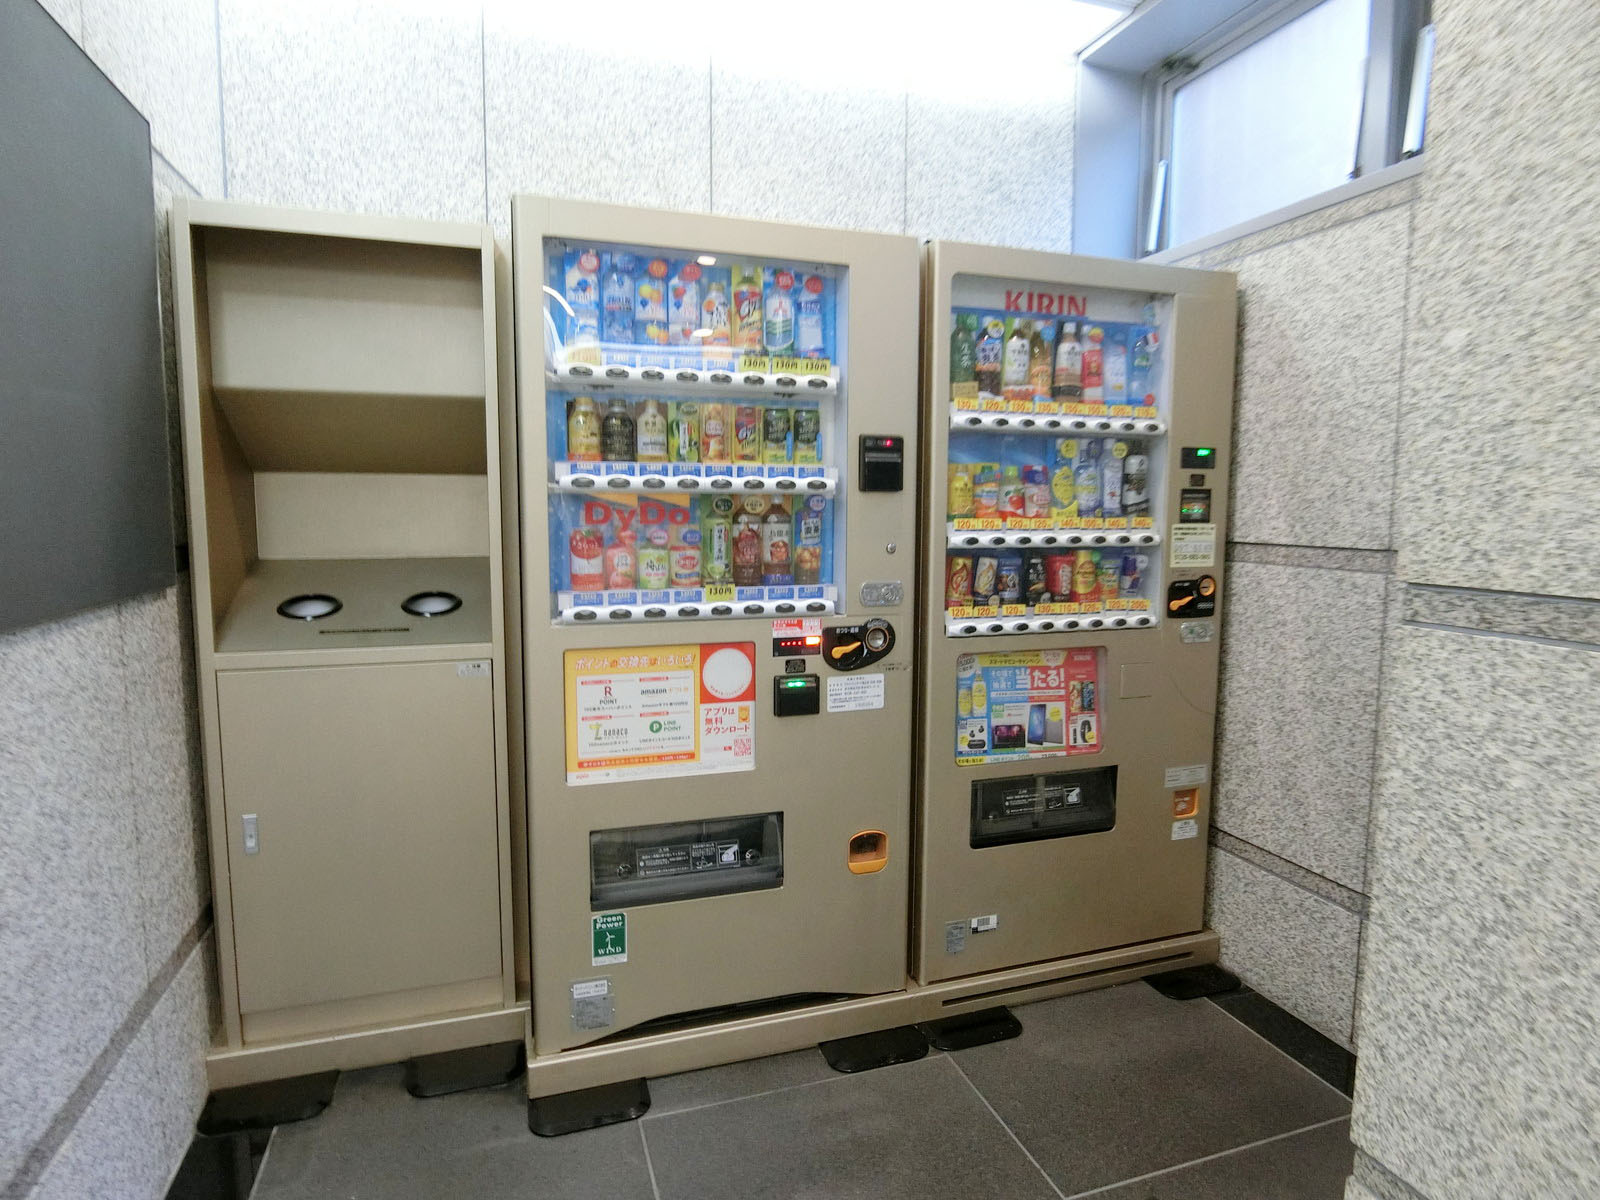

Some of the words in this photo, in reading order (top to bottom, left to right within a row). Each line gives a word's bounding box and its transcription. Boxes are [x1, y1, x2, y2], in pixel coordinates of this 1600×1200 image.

[1004, 288, 1087, 316] KIRIN
[743, 360, 766, 368] 130円
[776, 360, 798, 369] 130円
[806, 362, 827, 371] 130円
[584, 501, 690, 530] DyDo
[709, 587, 732, 595] 130円
[604, 686, 613, 697] R
[641, 687, 667, 696] amazon
[704, 707, 735, 716] アプリは
[704, 716, 722, 726] 無料
[603, 728, 628, 737] nanaco
[704, 725, 750, 736] ダウンロード
[598, 946, 622, 955] WIND
